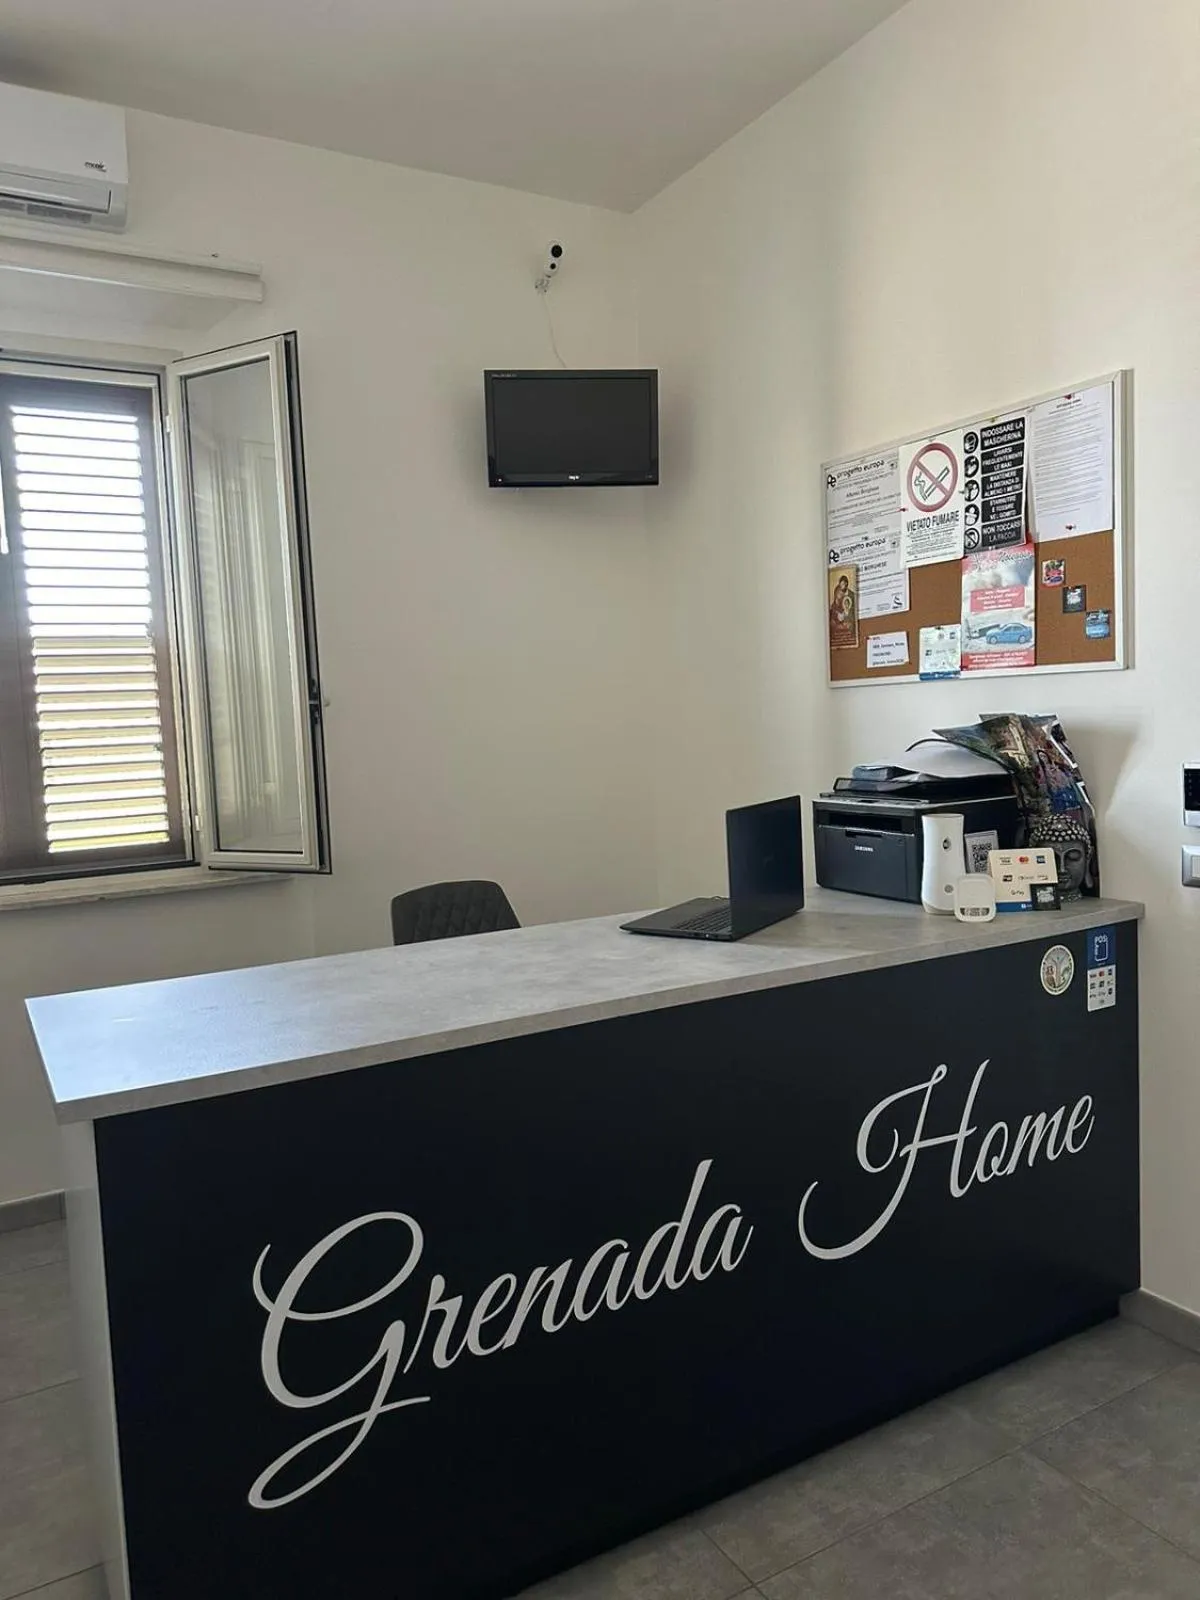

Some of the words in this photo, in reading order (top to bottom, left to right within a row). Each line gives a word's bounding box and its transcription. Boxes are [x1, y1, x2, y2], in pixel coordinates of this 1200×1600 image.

[982, 423, 1014, 438] INDOSSARE
[1015, 420, 1023, 429] LA
[983, 433, 1021, 446] MASCHERINA
[864, 460, 885, 472] europa
[906, 516, 931, 532] VIETATO
[932, 510, 960, 528] FUMARE
[982, 525, 995, 535] NON
[865, 538, 886, 549] europa
[989, 534, 997, 542] LA
[248, 1159, 754, 1509] Grenada
[799, 1059, 1095, 1260] Home
